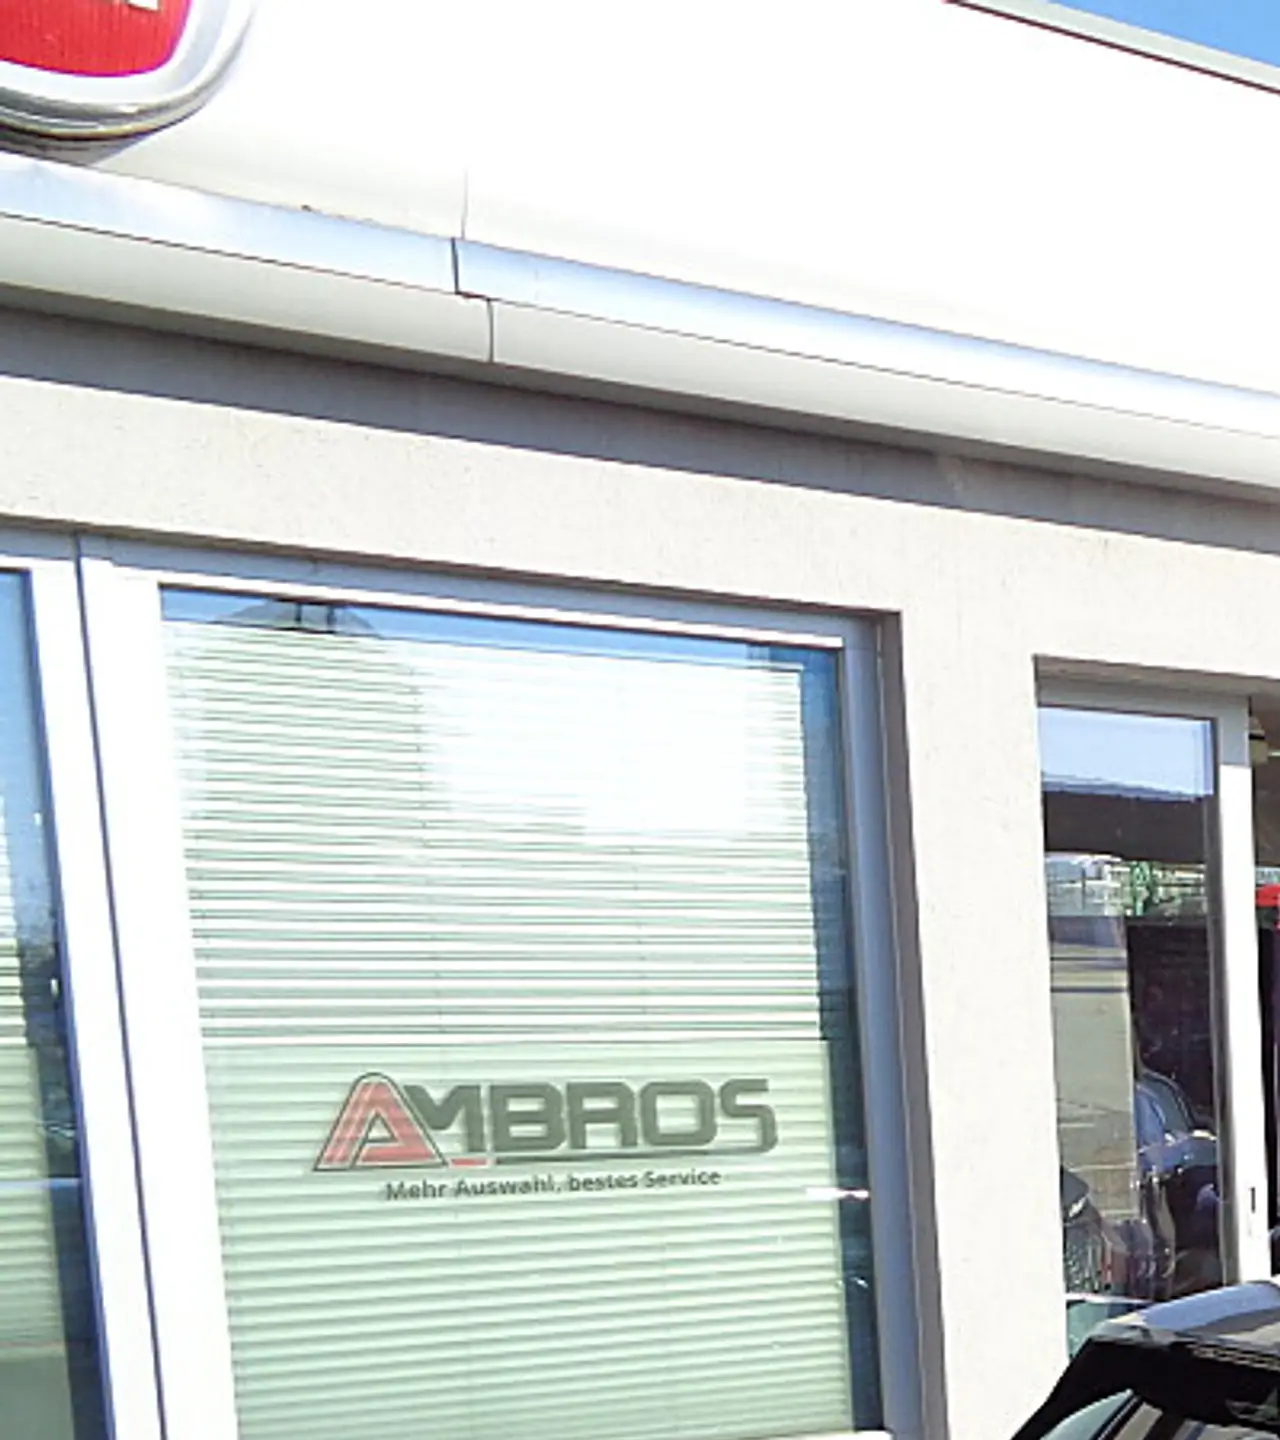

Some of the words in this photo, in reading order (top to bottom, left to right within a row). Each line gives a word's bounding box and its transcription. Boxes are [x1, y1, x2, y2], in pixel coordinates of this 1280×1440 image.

[313, 1072, 779, 1171] AMBROS
[385, 1179, 448, 1201] Mehr
[453, 1174, 561, 1198] Auswahl,
[567, 1170, 640, 1193] bestes
[645, 1168, 723, 1189] Service
